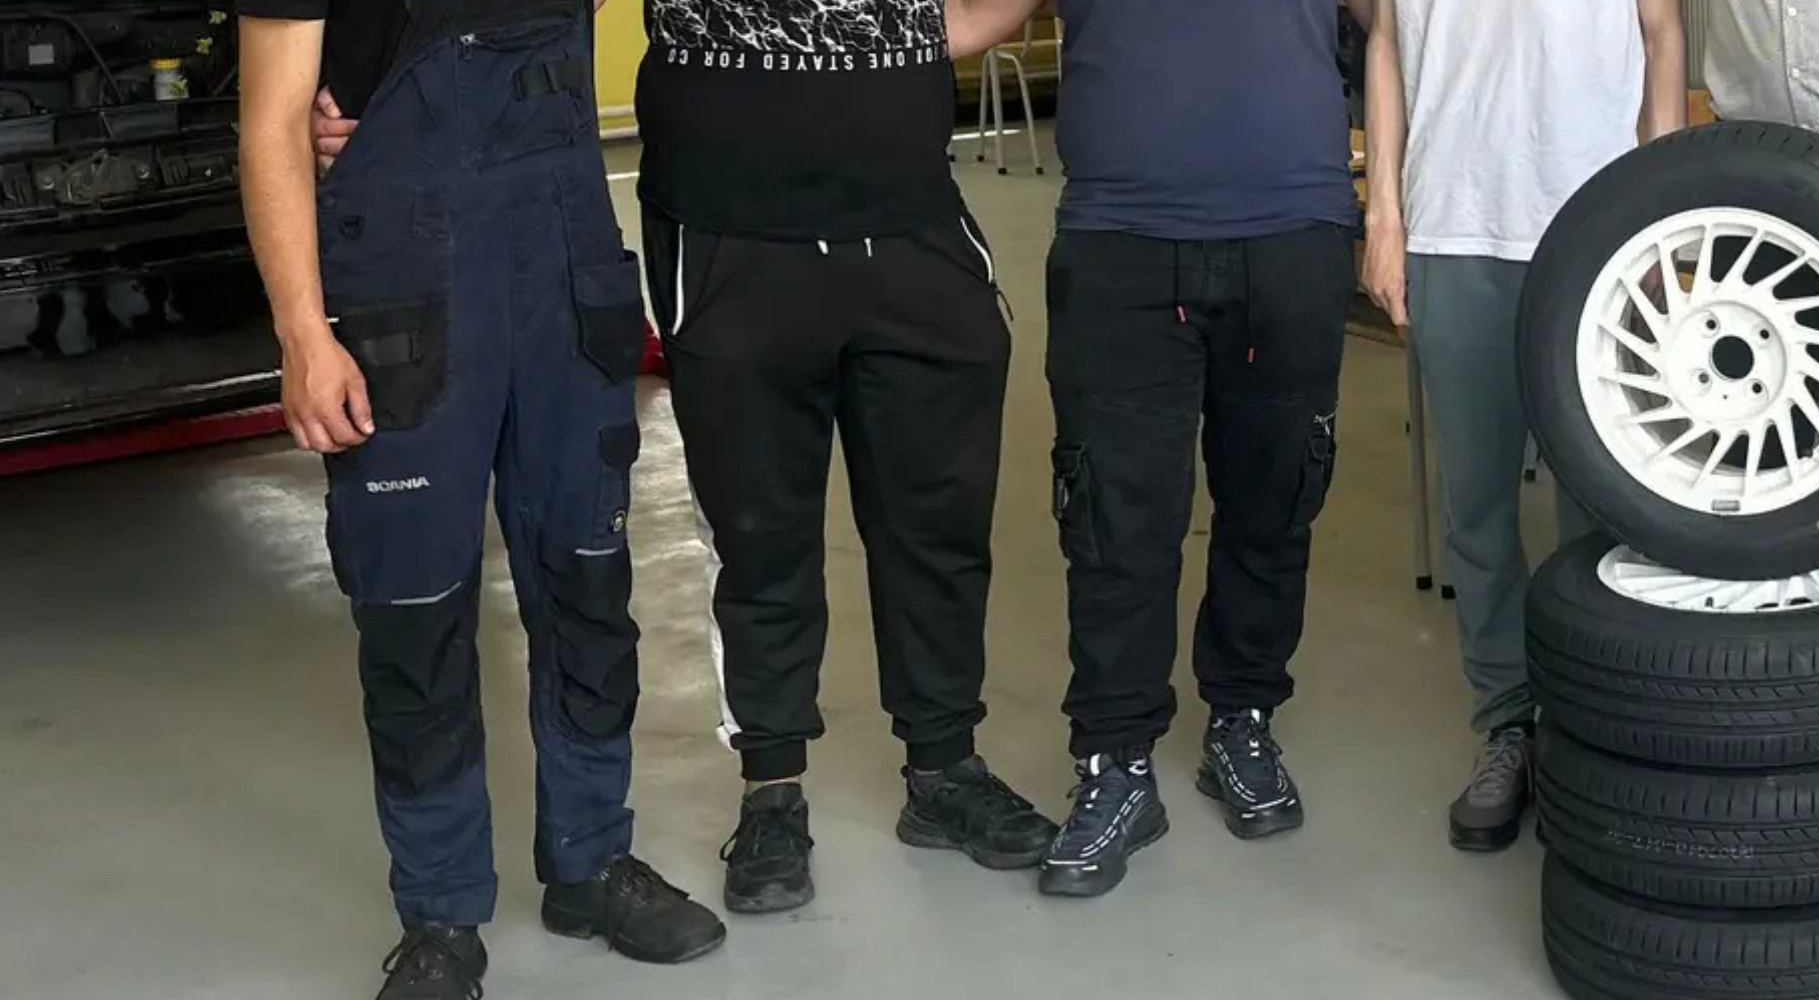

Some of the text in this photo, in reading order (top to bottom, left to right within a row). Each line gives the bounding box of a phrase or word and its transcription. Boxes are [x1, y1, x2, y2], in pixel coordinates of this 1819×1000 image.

[704, 51, 745, 69] FOR
[763, 53, 854, 72] STAYED
[868, 51, 905, 69] ONE
